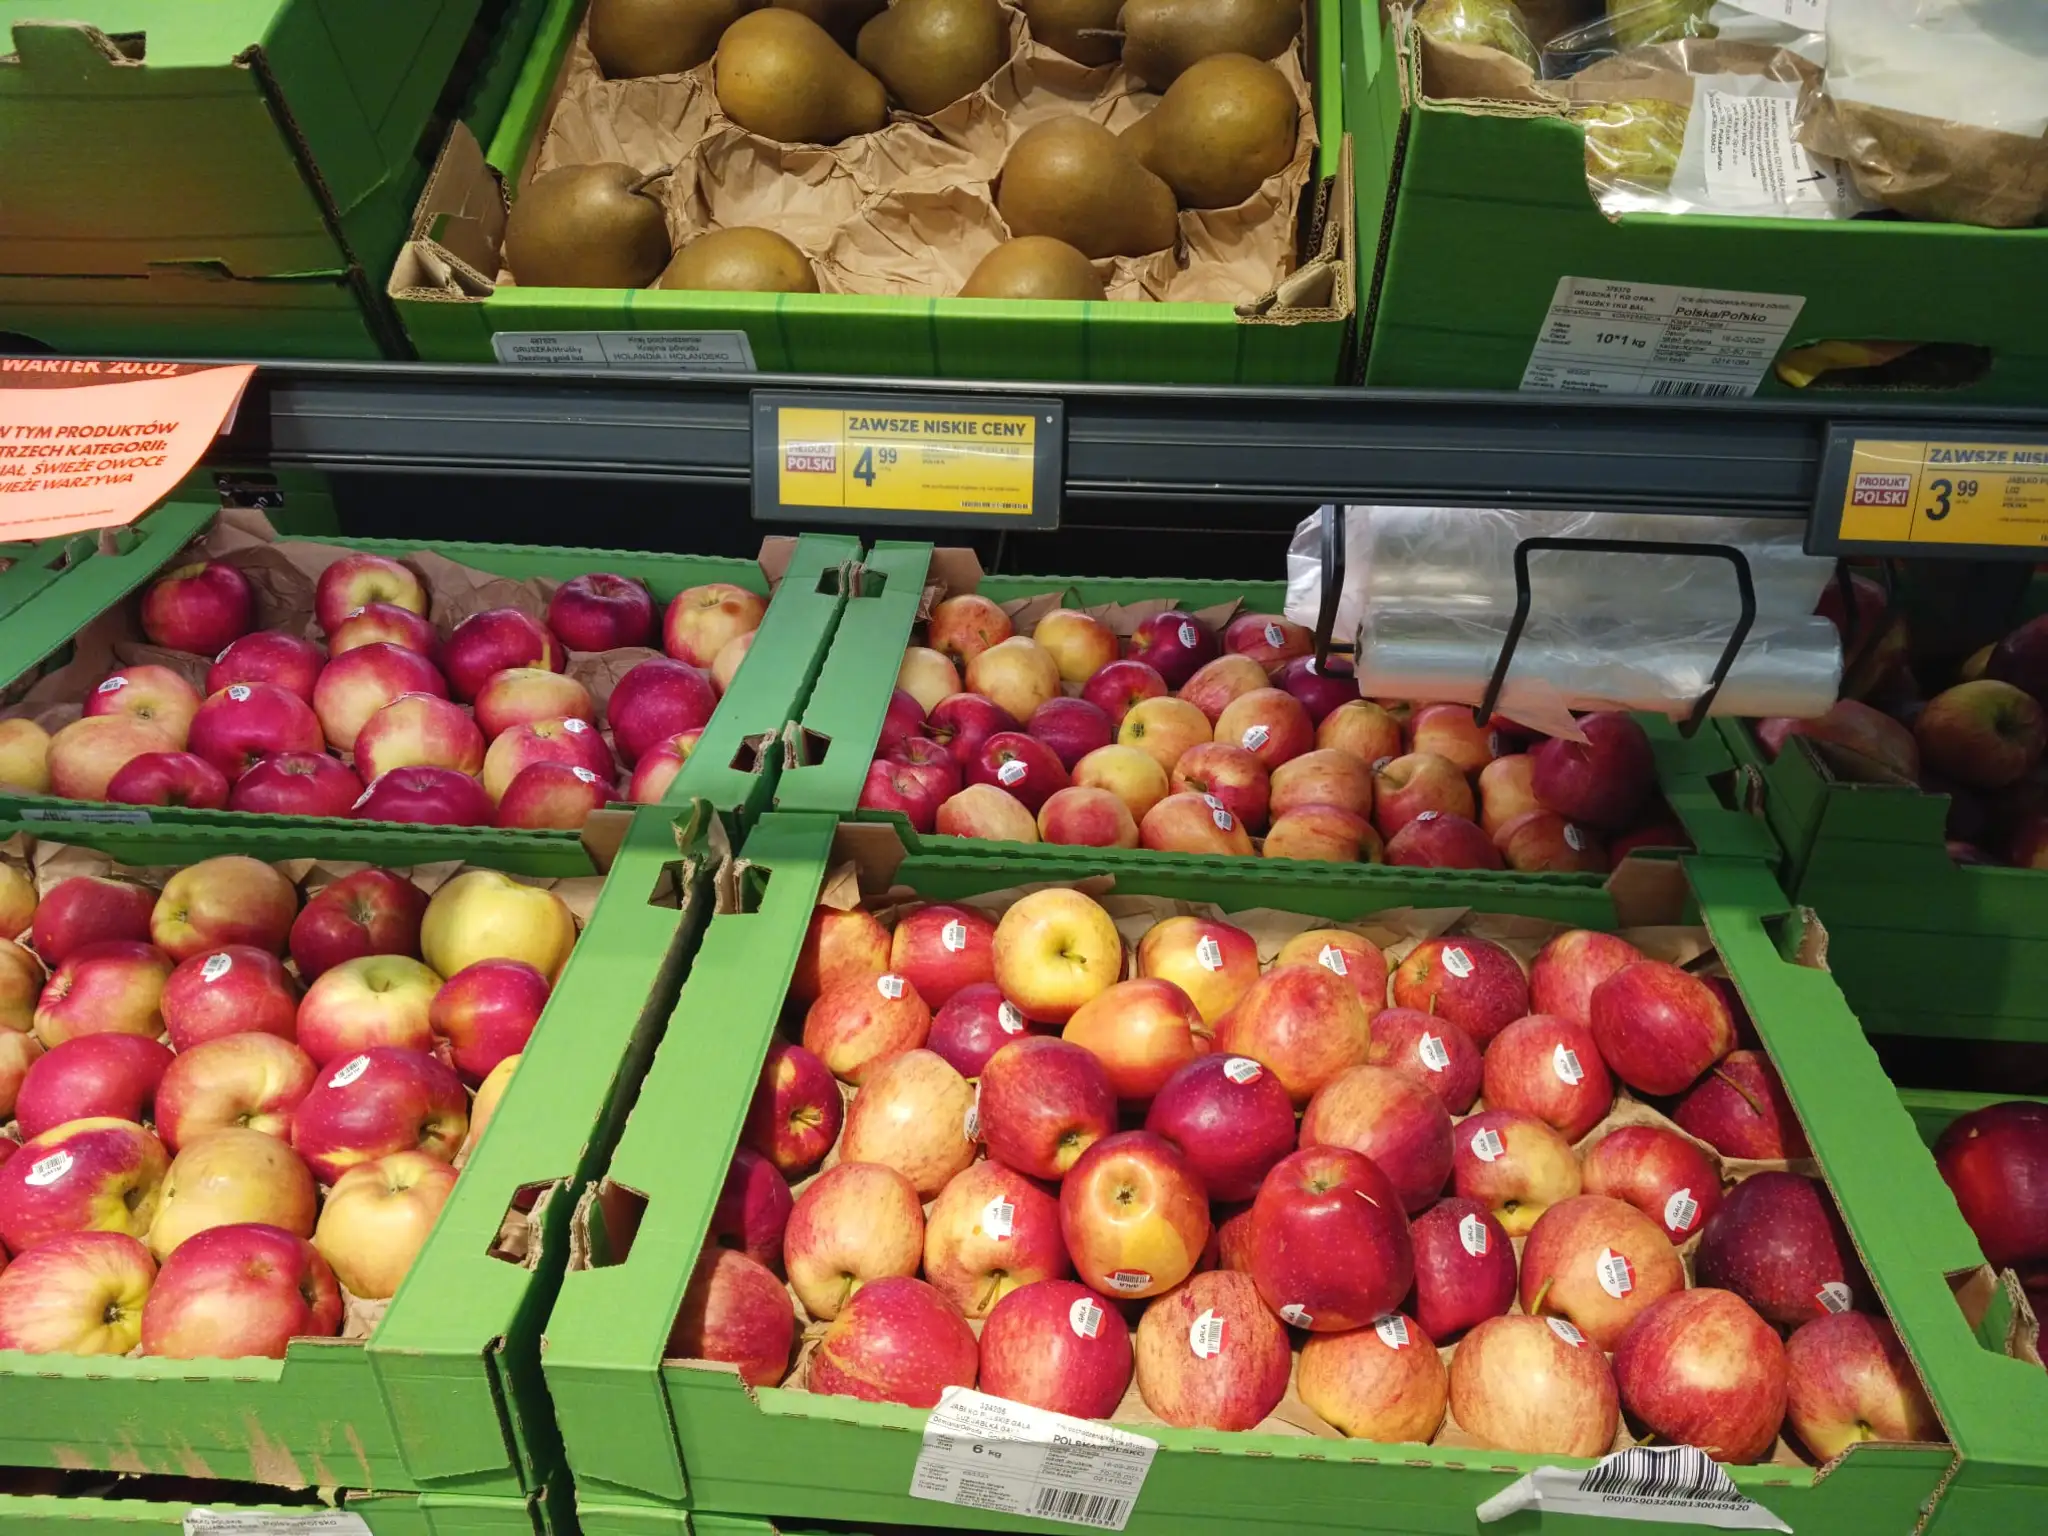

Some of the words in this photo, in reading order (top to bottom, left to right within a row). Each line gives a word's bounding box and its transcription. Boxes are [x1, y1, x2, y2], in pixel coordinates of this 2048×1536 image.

[1797, 170, 1827, 184] 1
[1676, 307, 1767, 323] Polska/Poľsko
[1631, 338, 1647, 348] kg
[16, 426, 52, 439] TYM
[55, 420, 180, 438] PRODUKTÓW
[848, 416, 920, 434] ZAWSZE
[923, 419, 978, 436] NISKIE
[982, 422, 1026, 437] CENY
[0, 445, 65, 458] TRZECH
[65, 439, 168, 456] KATEGORII:
[1929, 448, 2008, 464] ZAWSZE
[32, 456, 95, 476] ŚWIEŻE
[96, 454, 166, 469] OWOCE
[786, 456, 836, 472] POLSKI
[853, 446, 877, 488] 4
[878, 447, 898, 465] 99
[43, 473, 135, 491] WARZYWA
[1858, 476, 1908, 488] PRODUKT
[1854, 491, 1907, 505] POLSKI
[1925, 478, 1953, 521] 3
[1956, 479, 1979, 498] 99
[1672, 1200, 1684, 1218] GALA
[1604, 1264, 1616, 1285] GALA
[1078, 1305, 1087, 1323] GALA
[1198, 1323, 1207, 1344] GALA
[972, 1443, 984, 1454] 6
[988, 1449, 1002, 1459] kg
[1601, 1494, 1750, 1512] (00)059032408130049420
